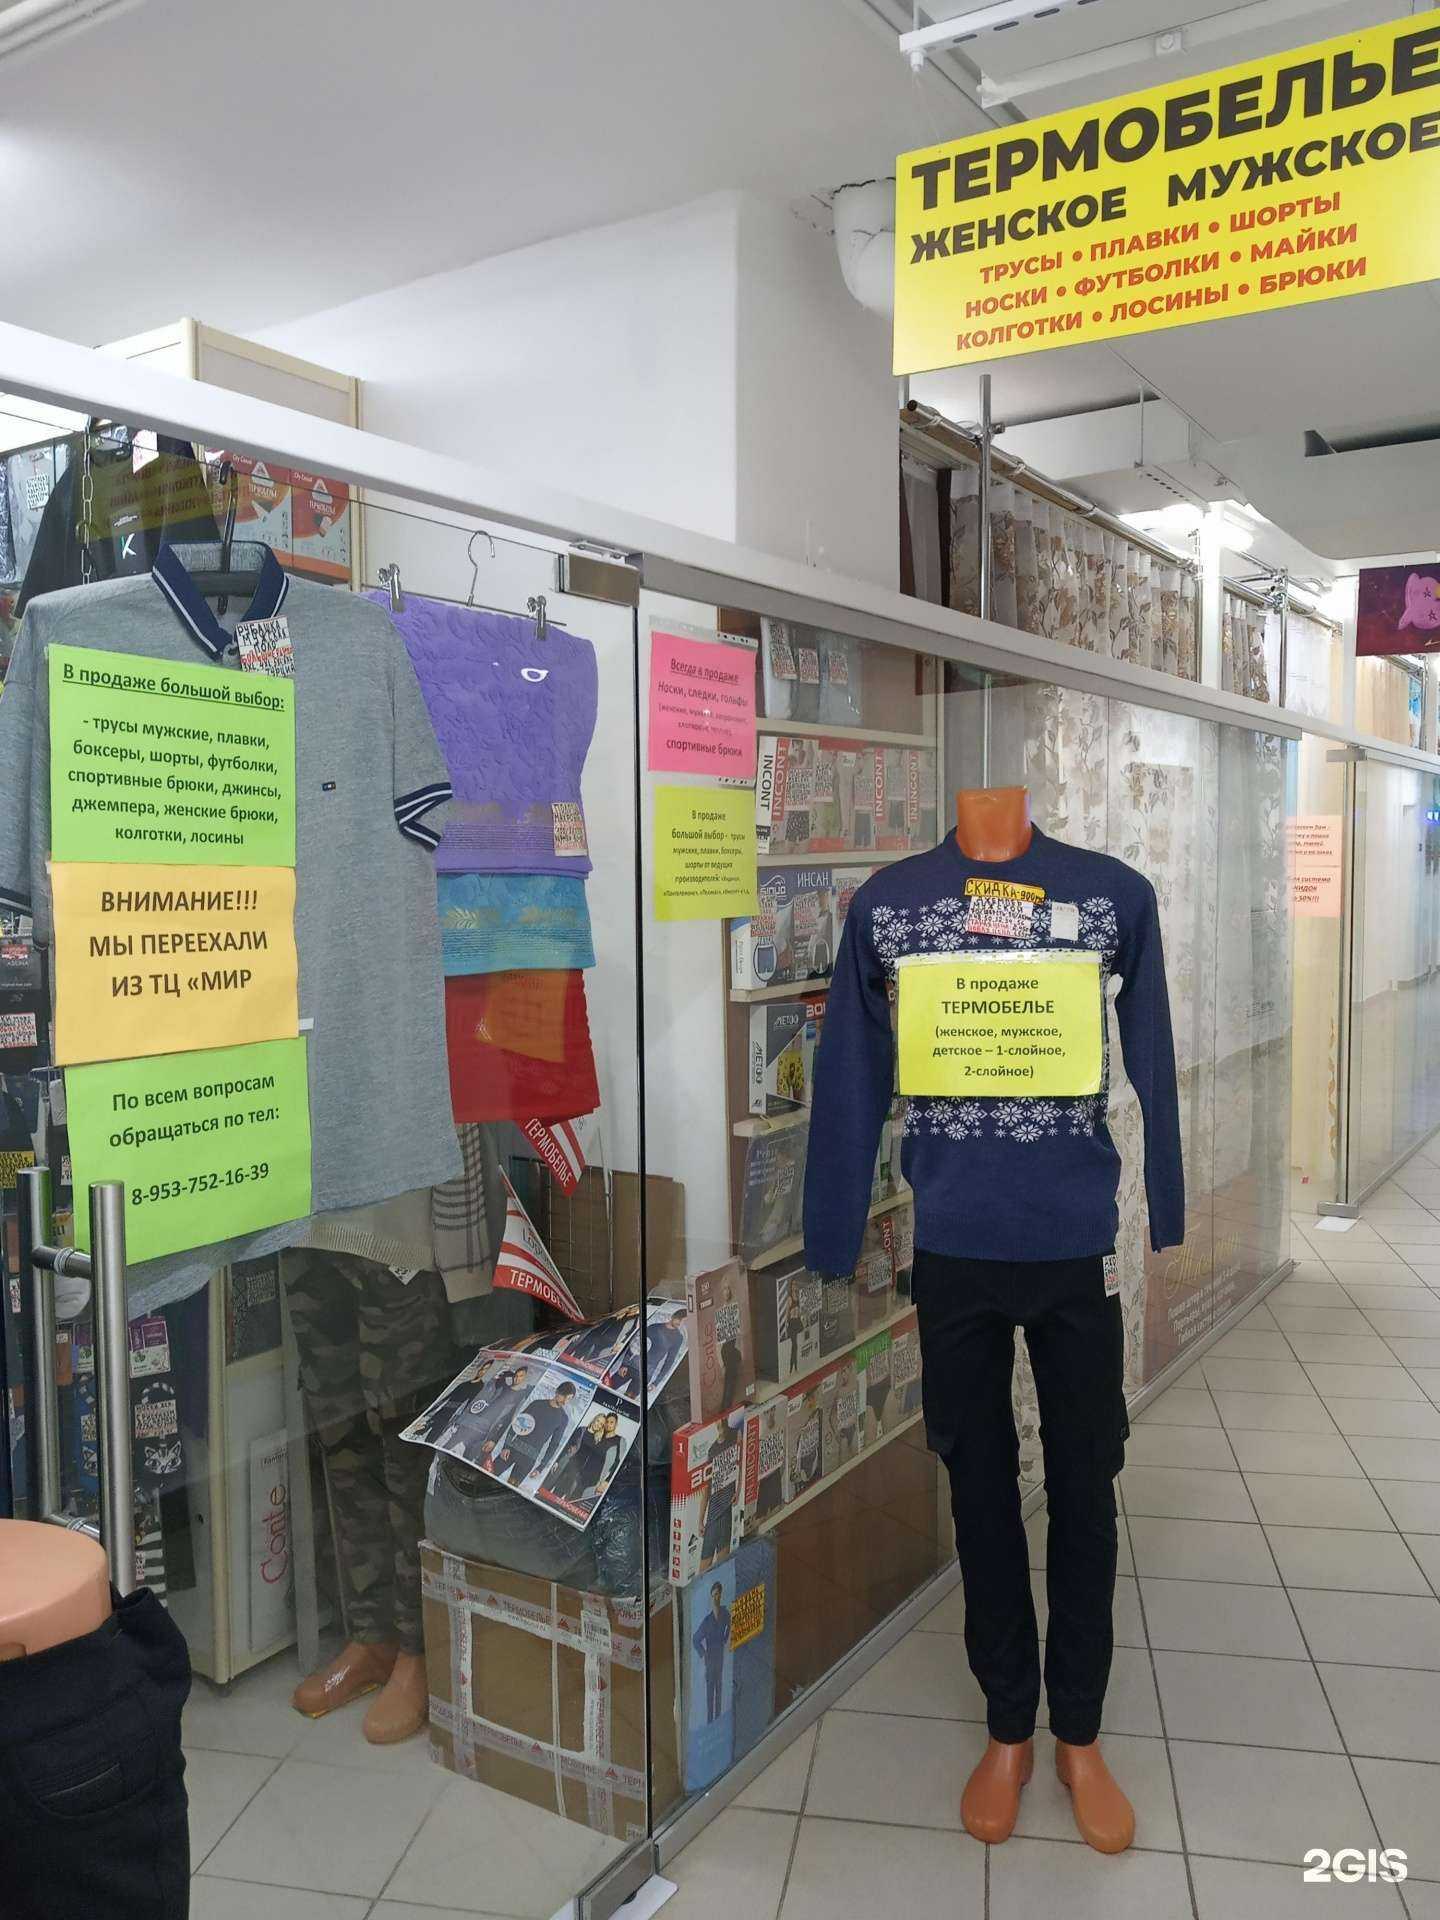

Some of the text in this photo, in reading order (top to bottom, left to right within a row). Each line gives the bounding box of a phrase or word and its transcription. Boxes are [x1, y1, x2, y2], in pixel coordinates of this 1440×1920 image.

[911, 26, 1440, 211] ТЕРМОБЕЛЬЕ
[910, 112, 1440, 264] ЖЕНСКОЕ МУЖСКОЕ
[980, 192, 1341, 286] ТРУСЫ ПЛАВКИ ШОРТЫ
[965, 223, 1358, 320] НОСКИ ФУТБОЛКИ МАЙКИ
[956, 257, 1367, 352] КОЛГОТКИ ЛОСИНЫ БРЮКИ
[671, 658, 697, 674] Всегда
[704, 668, 739, 682] продаже
[63, 663, 285, 710] В продаже большой выбор:
[658, 682, 687, 697] Носки,
[688, 689, 719, 704] следки,
[93, 717, 138, 734] трусы
[142, 723, 213, 743] мужские,
[217, 732, 270, 750] плавки,
[666, 740, 743, 757] спортивные брюки
[73, 740, 278, 775] боксеры, шорты, футболки,
[68, 770, 282, 800] спортивные брюки, джинсы,
[761, 755, 773, 811] INCONT
[773, 746, 787, 816] INCONT
[876, 755, 884, 817] INCONT
[72, 798, 278, 824] джемпера, женские брюки,
[692, 810, 726, 822] В продаже
[115, 827, 244, 845] колготки, лосины
[672, 828, 703, 840] большой
[704, 831, 725, 842] выбор
[101, 890, 258, 913] ВНИМАНИЕ!!!
[89, 931, 268, 958] МЫ ПЕРЕЕХАЛИ
[112, 969, 252, 998] ИЗ ТЦ «МИР
[957, 978, 1038, 992] В продаже
[942, 1001, 1054, 1014] ТЕРМОБЕЛЬЕ
[936, 1026, 1062, 1039] (женское, мужское,
[933, 1045, 982, 1057] детское
[997, 1045, 1066, 1057] 1-слойное,
[964, 1066, 1034, 1078] 2-слойное)
[112, 1074, 275, 1112] По всем вопросам
[109, 1107, 280, 1148] обращаться по тел:
[525, 1118, 573, 1187] ТЕРМОБЕЛЬЕ
[131, 1162, 270, 1206] 8-953-752-16-39
